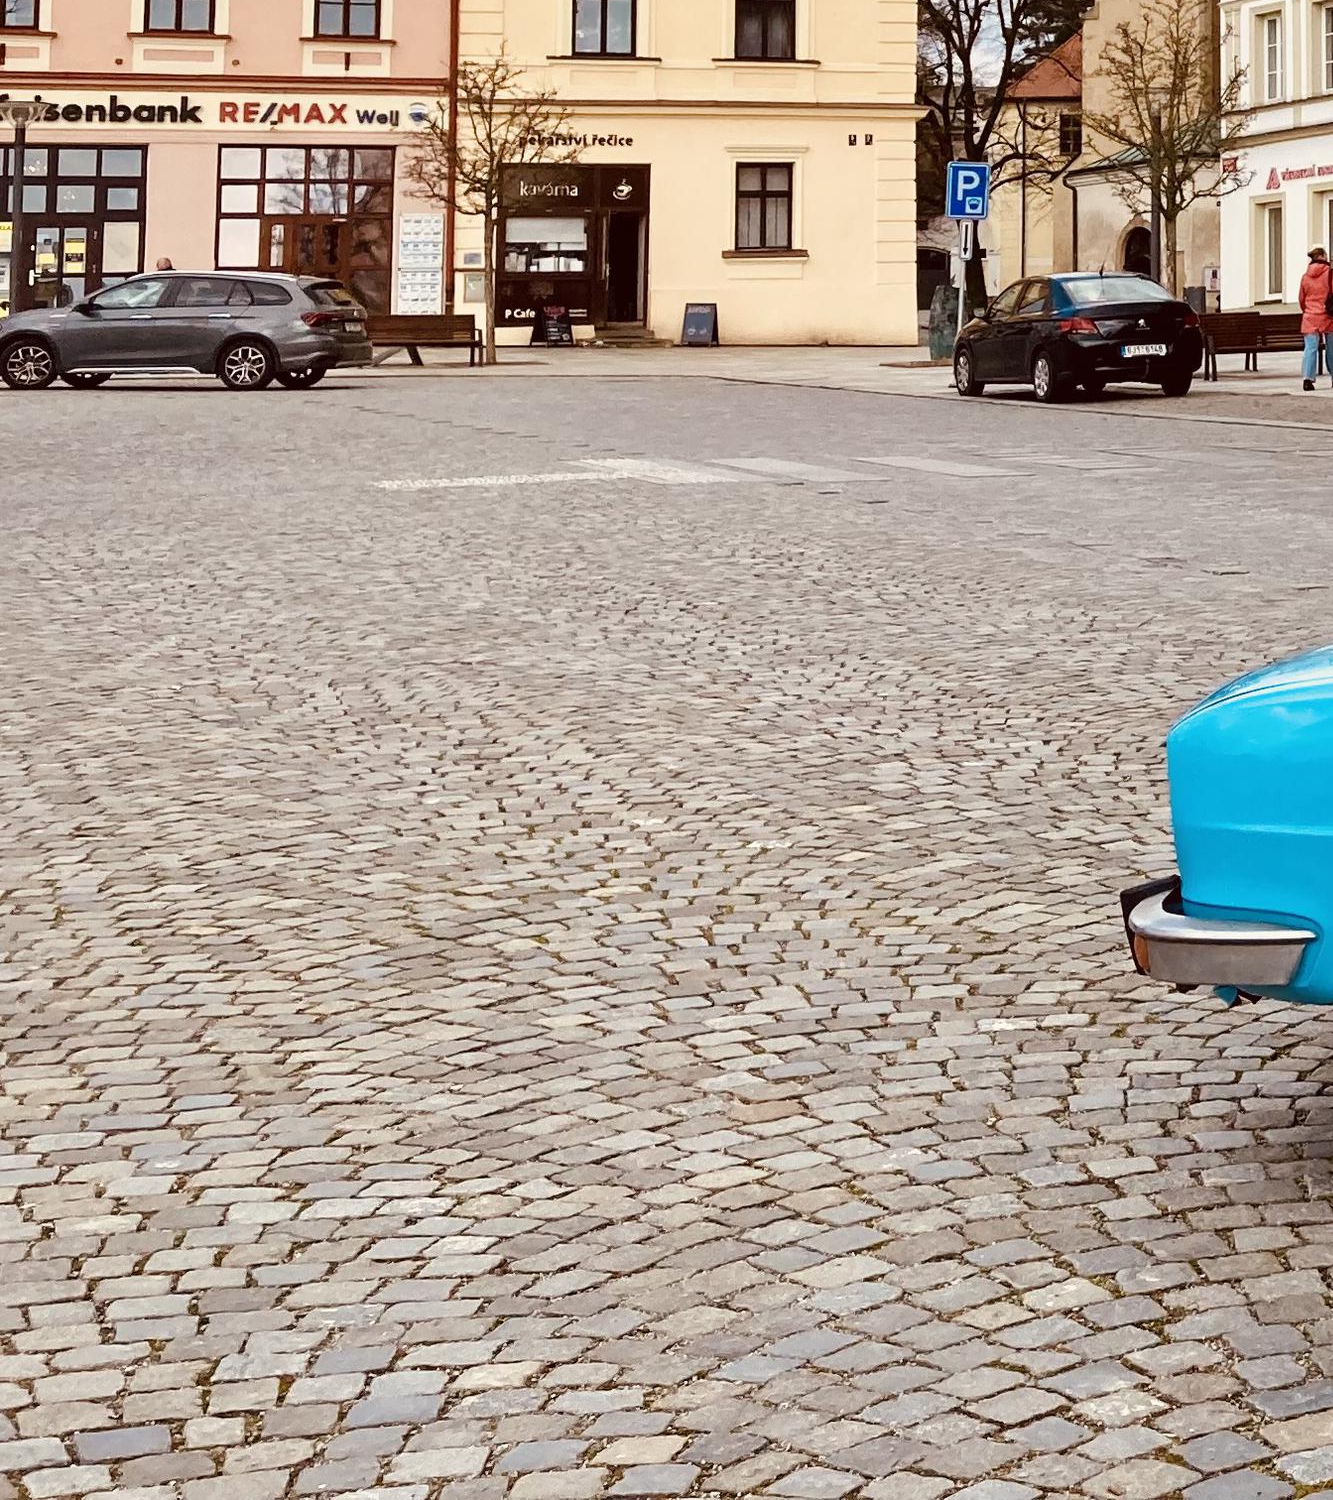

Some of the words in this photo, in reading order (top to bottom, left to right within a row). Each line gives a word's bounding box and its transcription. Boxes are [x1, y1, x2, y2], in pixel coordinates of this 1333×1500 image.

[0, 93, 203, 123] isenbank
[219, 102, 348, 124] RE/MAX
[591, 134, 634, 147] řečice
[519, 180, 579, 197] kavárna
[956, 170, 980, 201] P
[513, 308, 536, 319] Cafe
